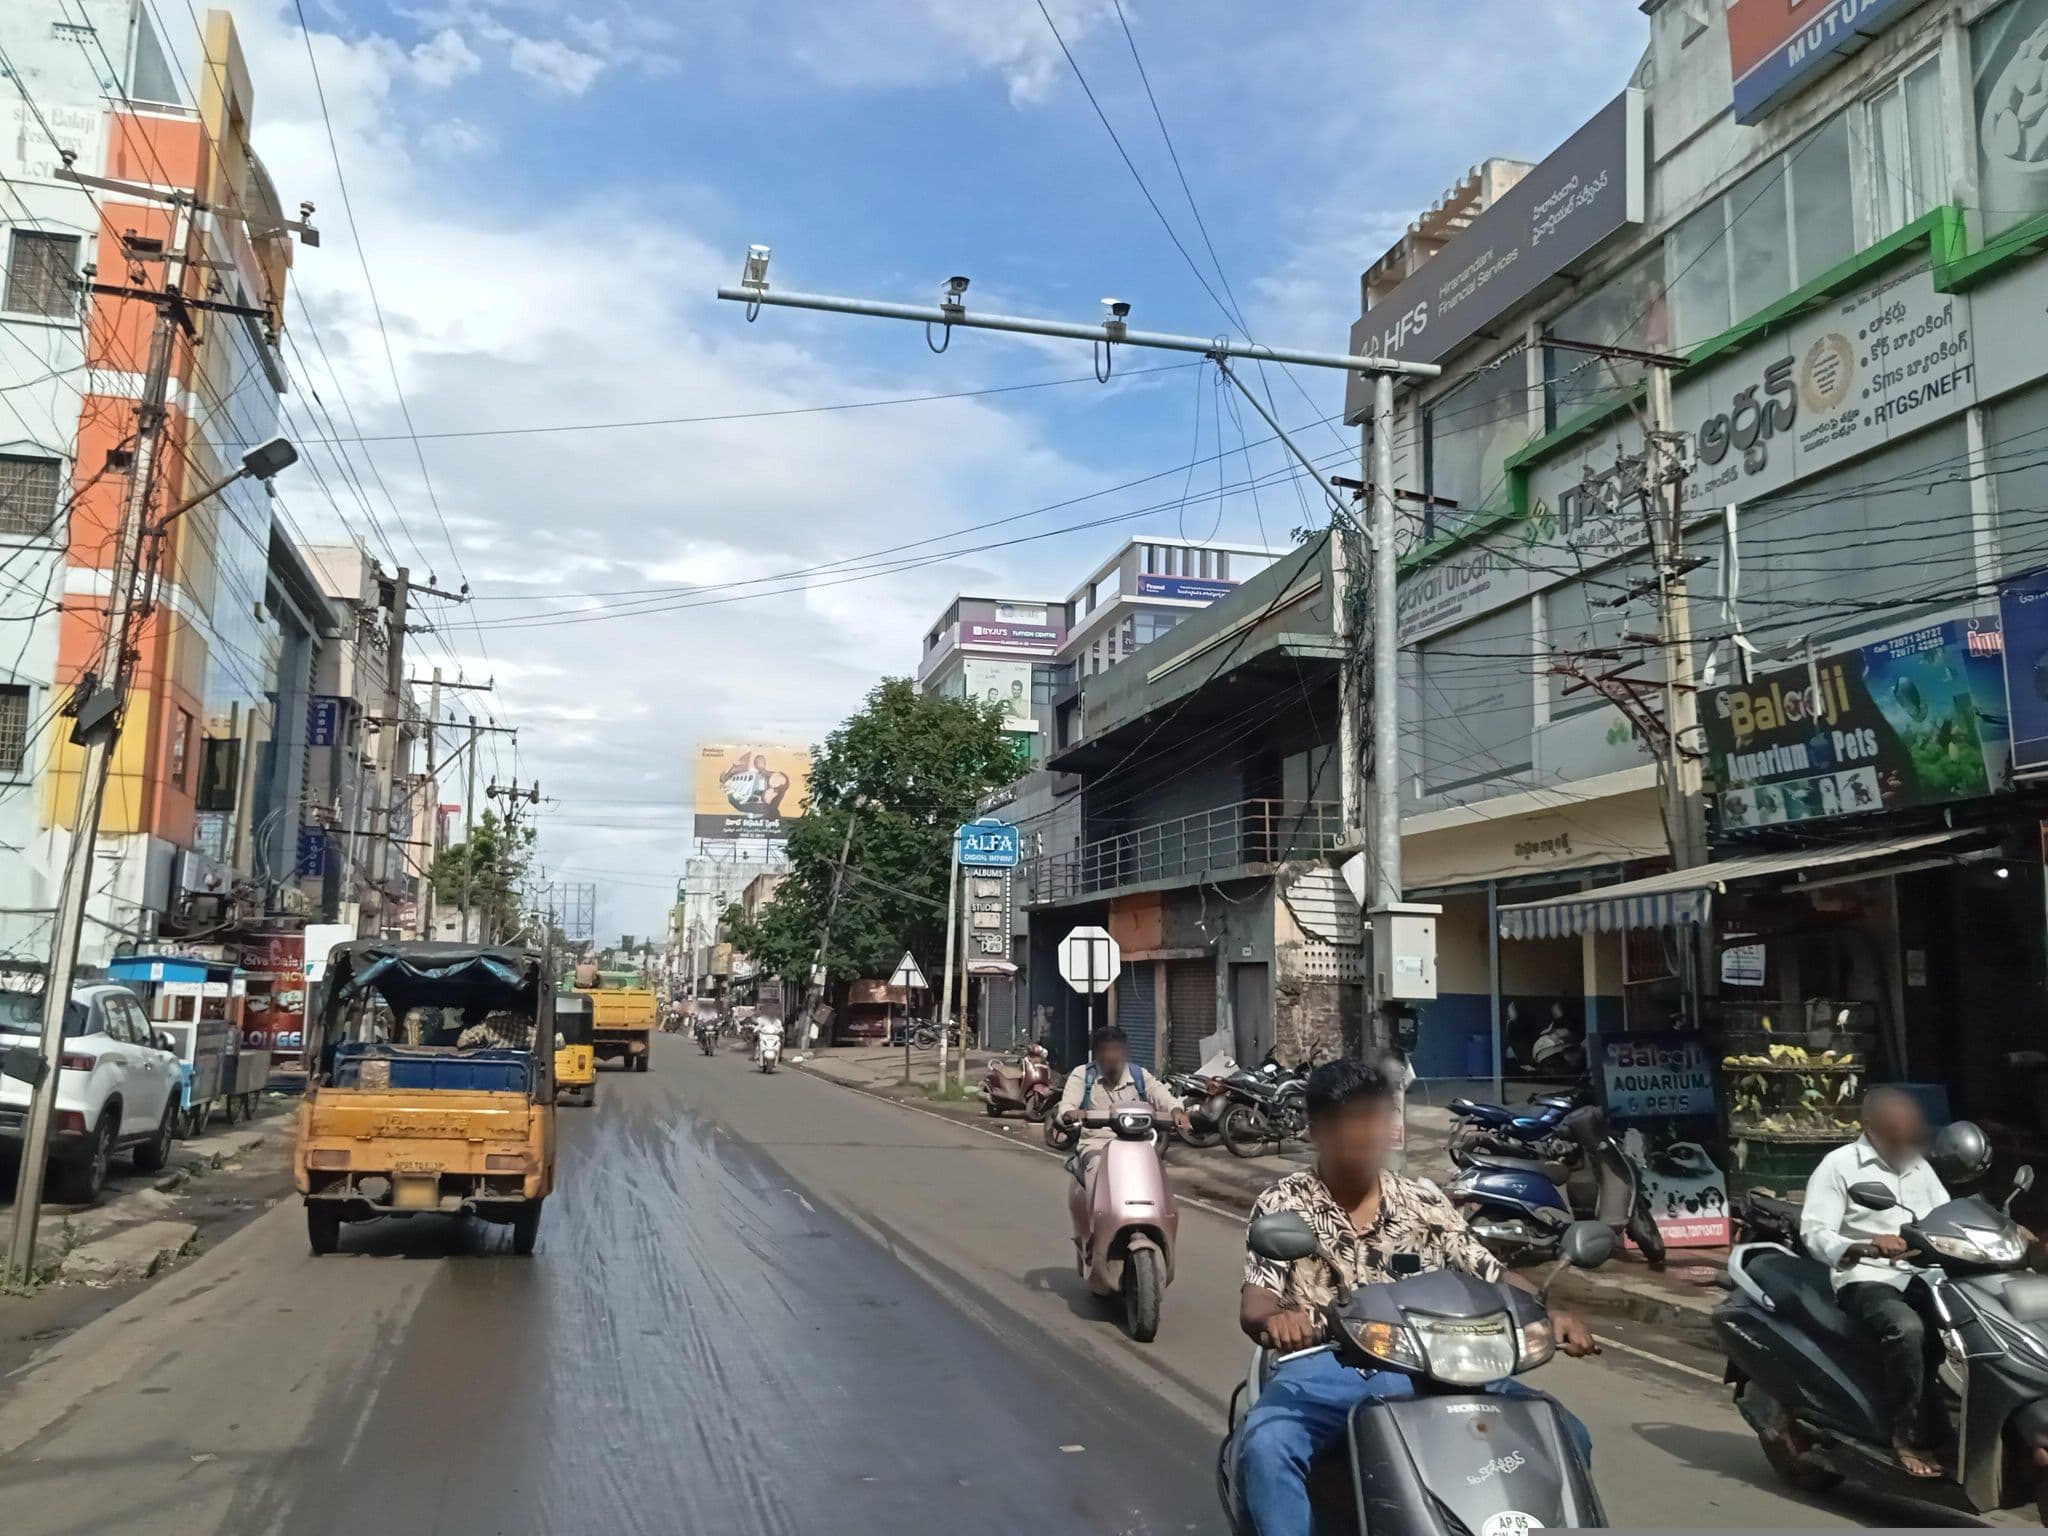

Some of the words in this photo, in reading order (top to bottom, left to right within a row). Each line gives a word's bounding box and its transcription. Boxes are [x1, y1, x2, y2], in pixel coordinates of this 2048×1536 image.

[1477, 248, 1518, 287] Services
[1383, 301, 1428, 359] HFS
[1874, 363, 1975, 425] RTGS/NEFT
[1446, 552, 1493, 591] Urban
[982, 627, 1008, 636] BYJU'S
[1831, 728, 1879, 762] Pets
[965, 833, 1013, 851] ALFA
[972, 869, 1003, 878] ALBUMS
[1646, 1095, 1689, 1112] PETS
[1446, 1403, 1501, 1414] HONDA
[1500, 1516, 1513, 1529] AP
[1515, 1516, 1529, 1529] 05
